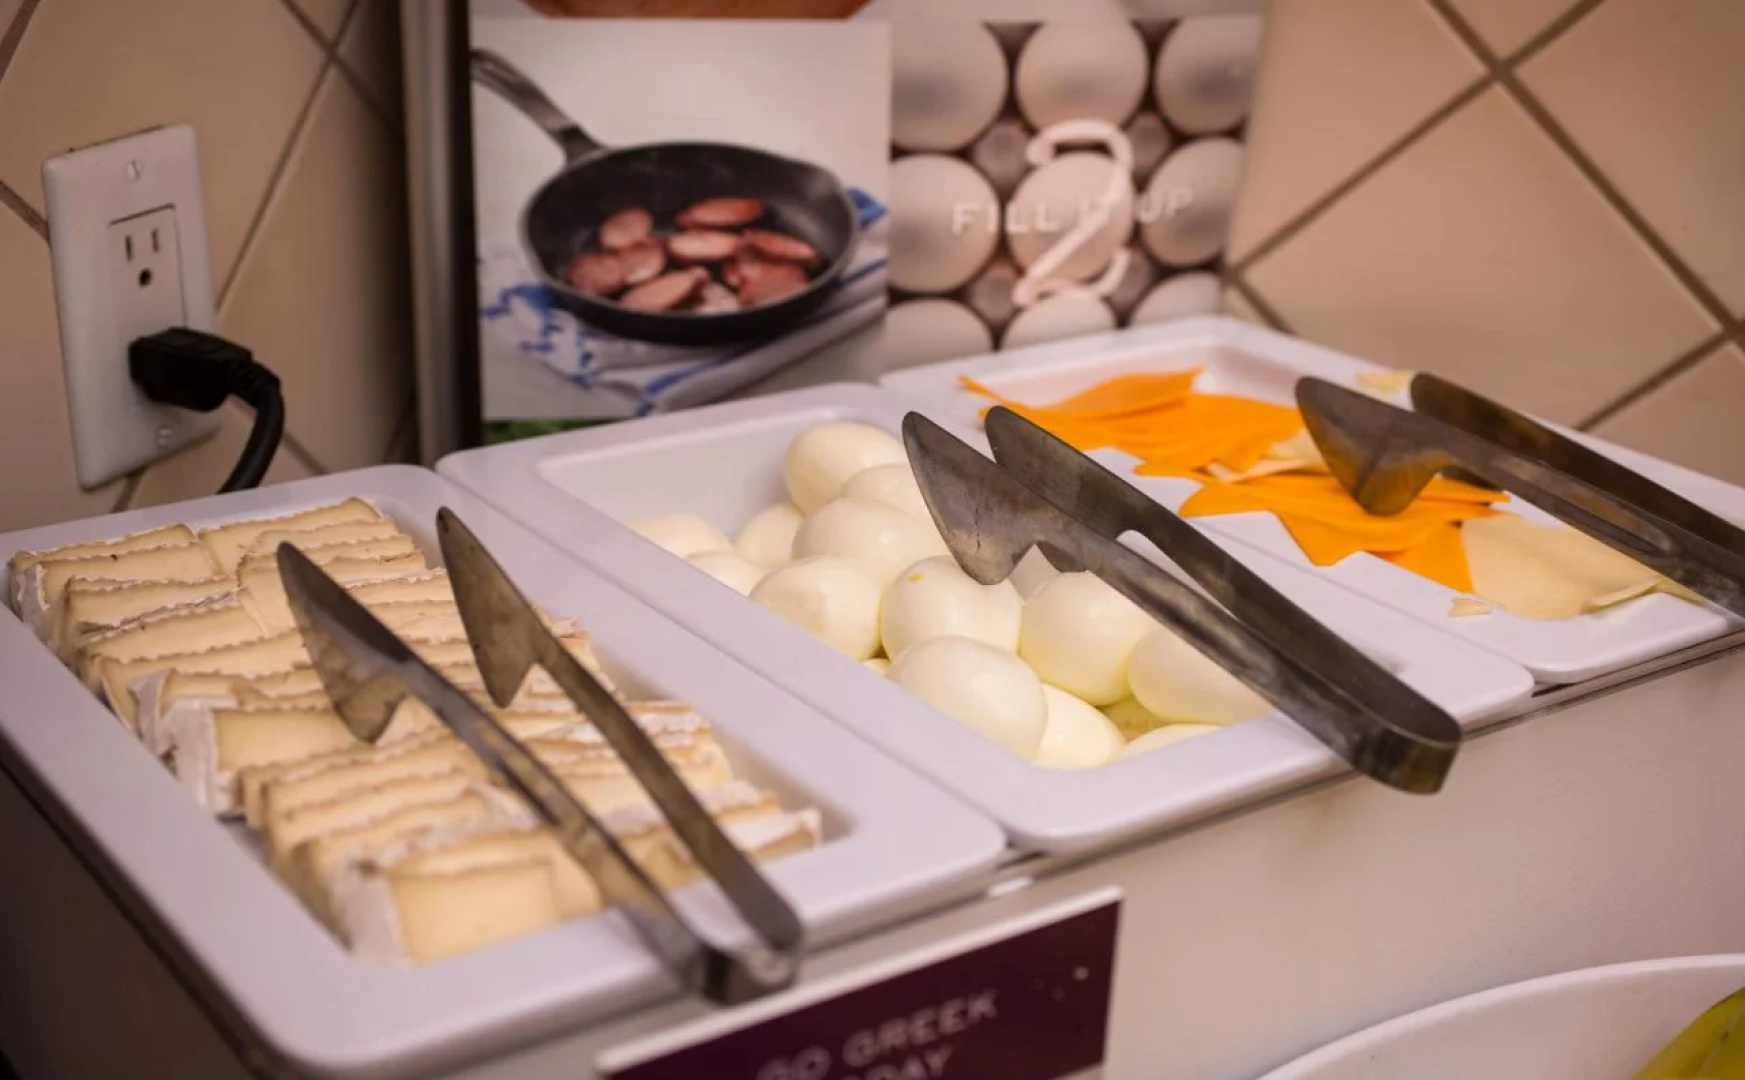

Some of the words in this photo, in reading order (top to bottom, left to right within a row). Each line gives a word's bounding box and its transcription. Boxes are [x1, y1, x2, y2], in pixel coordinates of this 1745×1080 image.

[952, 202, 1058, 235] FILL
[1139, 187, 1194, 224] UP
[842, 988, 998, 1068] GREEK
